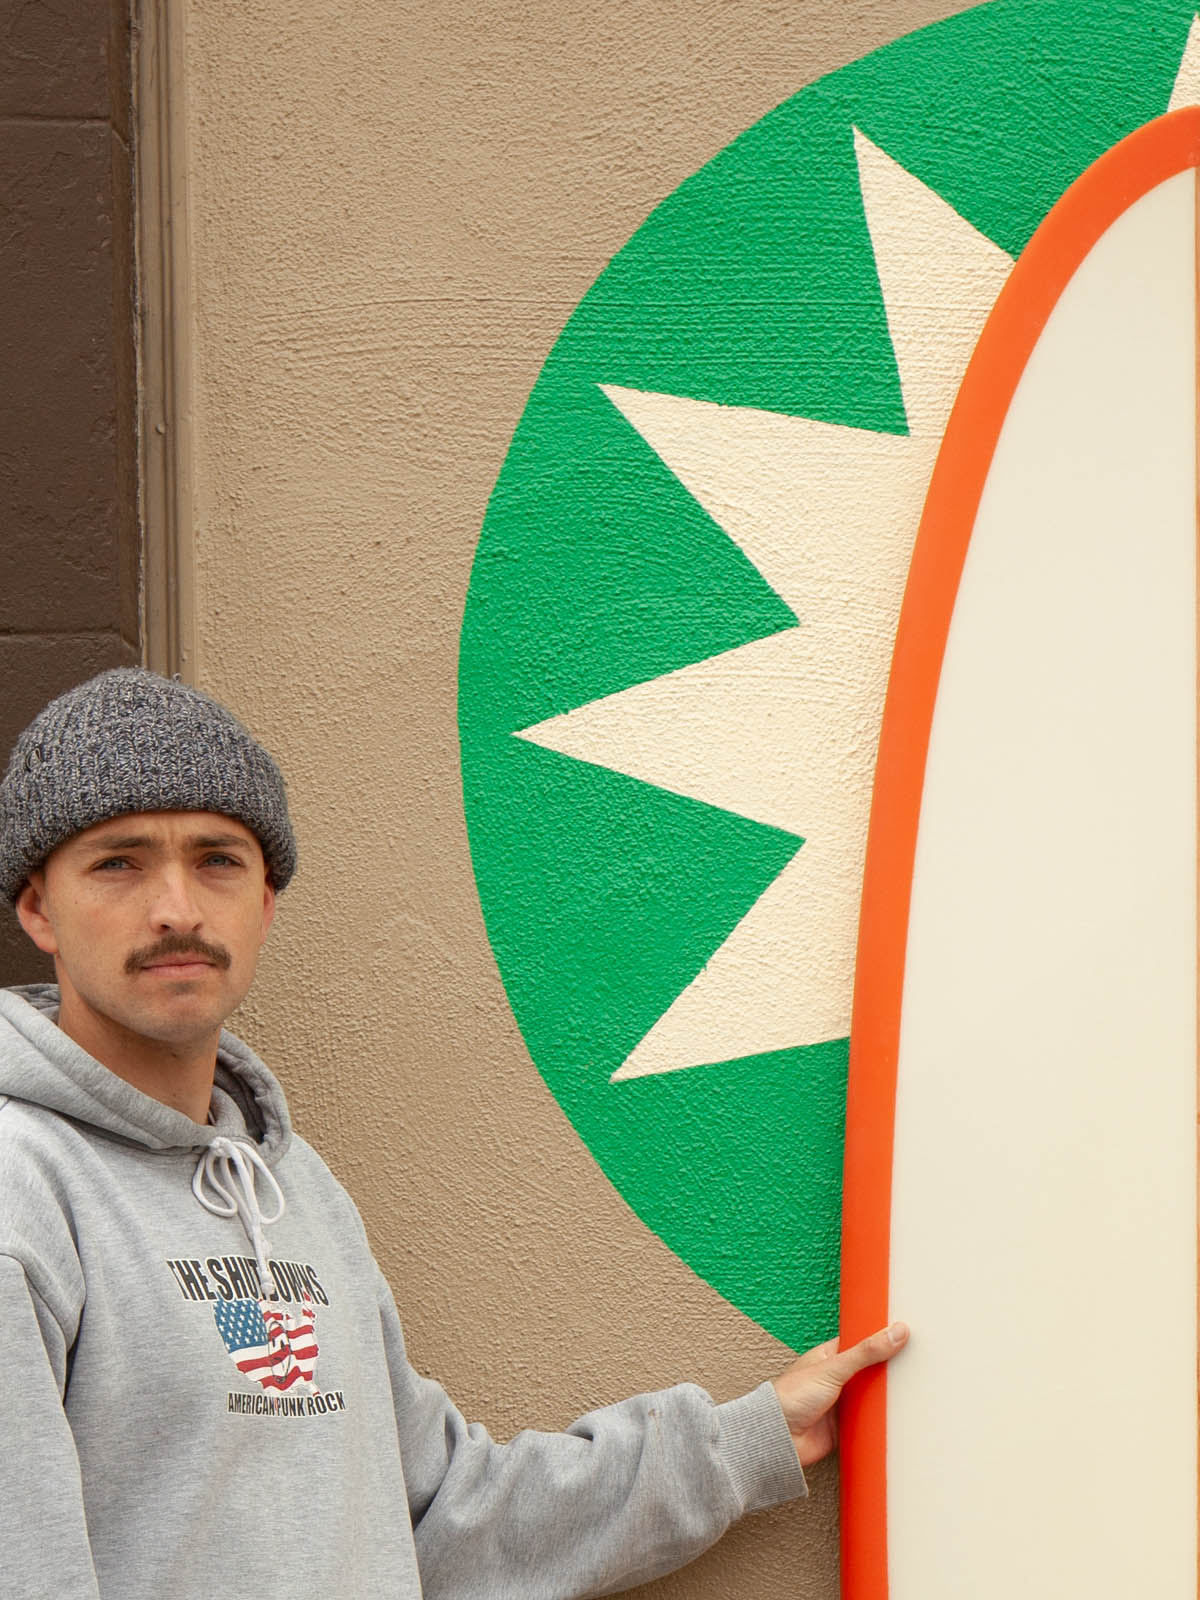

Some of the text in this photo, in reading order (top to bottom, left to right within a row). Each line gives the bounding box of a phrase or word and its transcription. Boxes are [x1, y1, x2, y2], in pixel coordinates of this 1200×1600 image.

[166, 1256, 329, 1306] THE SHUTOWNS
[228, 1391, 346, 1417] AMERICAN PUNK ROCK
